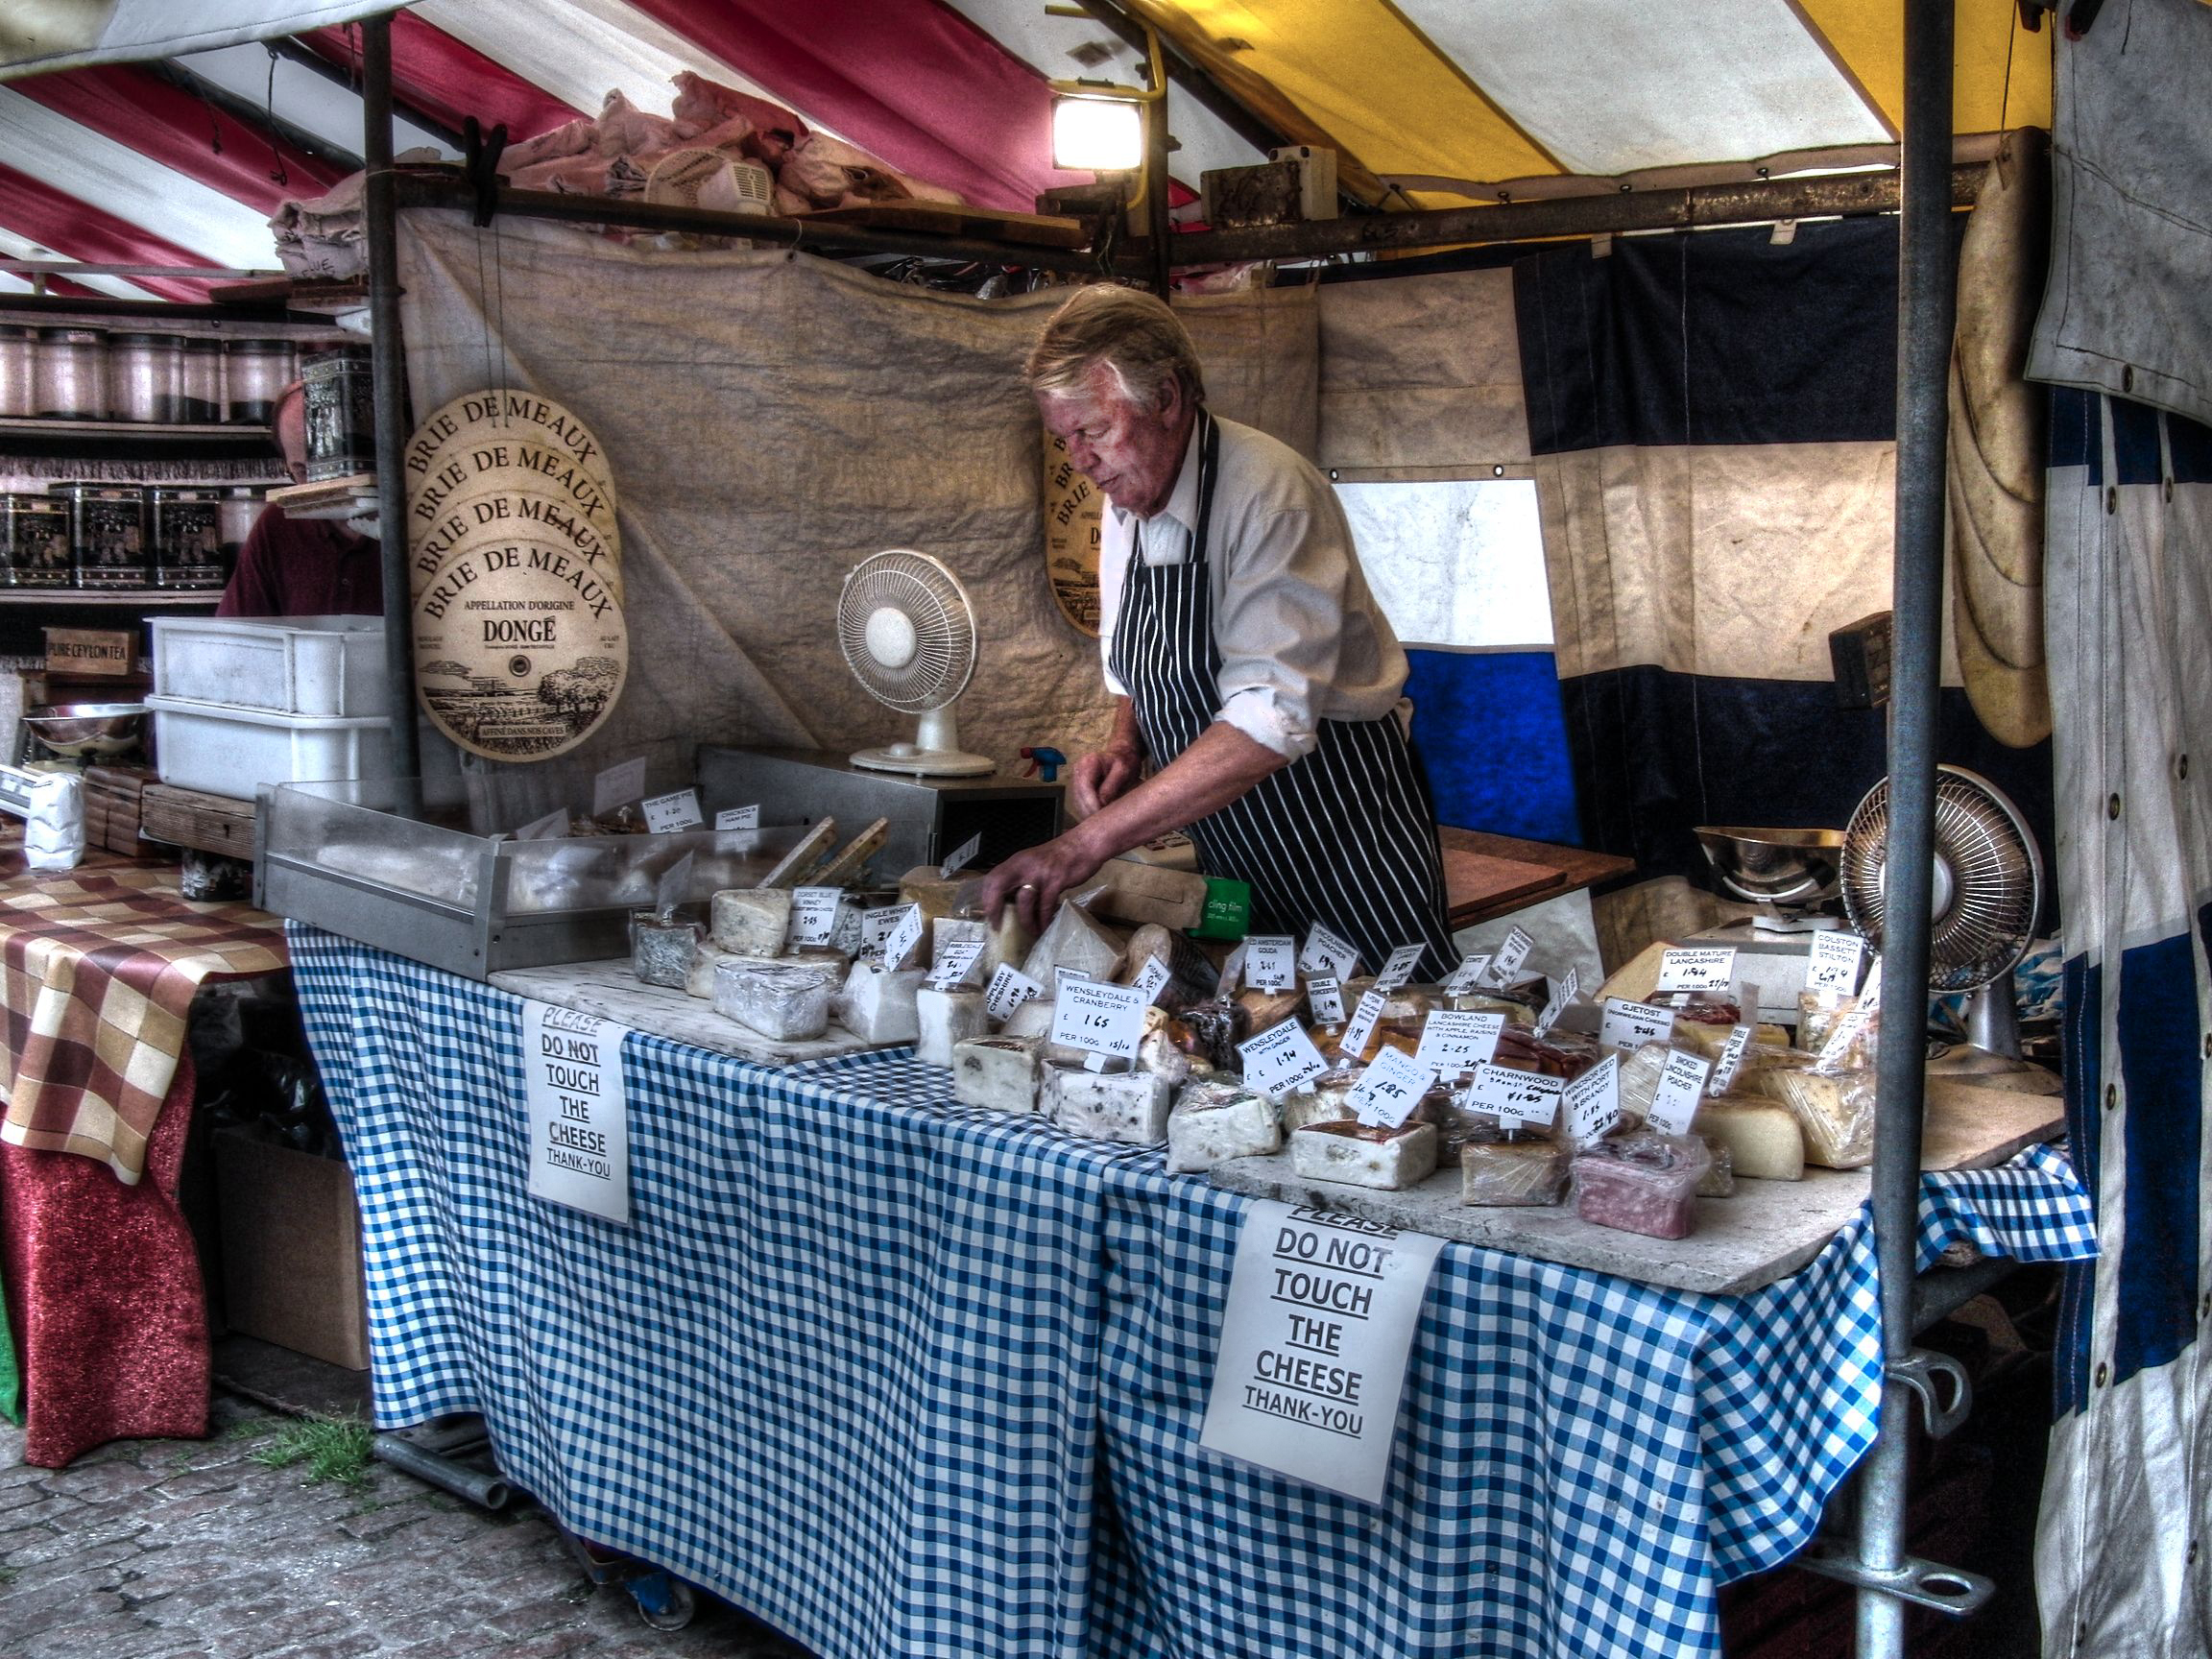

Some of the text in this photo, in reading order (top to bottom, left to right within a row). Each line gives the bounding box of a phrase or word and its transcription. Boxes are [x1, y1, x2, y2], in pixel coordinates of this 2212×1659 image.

[407, 397, 597, 474] BRIE DE MEAUX
[415, 446, 604, 521] BRIE DE MEAUX
[1057, 481, 1091, 526] BRIE
[417, 498, 607, 576] BRIE DE MEAUX
[423, 547, 613, 620] BRIE DE MEAUX
[464, 600, 575, 611] APPELLATION D'ORIGINE
[483, 615, 557, 642] DONGÉ
[73, 644, 108, 659] CEYLON
[109, 646, 126, 661] TEA
[1208, 899, 1242, 912] cling film
[878, 916, 900, 925] EWES
[1318, 937, 1346, 960] POACHER
[1818, 934, 1859, 948] COLSTON
[1818, 944, 1857, 954] BASSETT
[1818, 951, 1854, 964] STILTON
[989, 972, 1014, 1012] CHESHIRE
[1066, 984, 1131, 1004] WENSLEYDALE
[1073, 996, 1128, 1011] CRANBERRY
[542, 1006, 607, 1035] PLEASE
[1441, 1013, 1487, 1022] BOWLAND
[1623, 1003, 1661, 1017] GJETOST
[542, 1034, 599, 1063] DO NOT
[1059, 1032, 1076, 1041] PER
[1079, 1036, 1099, 1046] 100G
[1242, 1022, 1297, 1053] WENSLEYDALE
[1271, 1036, 1290, 1048] GINGER
[1619, 1040, 1633, 1048] PER
[1380, 1062, 1416, 1086] GINGER
[1384, 1052, 1419, 1076] MANGO
[1665, 1063, 1703, 1084] LINCOLNSHIRE
[1675, 1055, 1697, 1070] SMOKED
[545, 1064, 600, 1093] TOUCH
[1269, 1073, 1304, 1094] PER 100G
[1482, 1068, 1558, 1087] CHARNWOOD
[1565, 1058, 1615, 1096] WINDSOR RED
[1572, 1070, 1611, 1101] WITH PORT
[1667, 1074, 1693, 1091] POACHER
[1579, 1080, 1610, 1106] BRANDY
[559, 1095, 589, 1119] THE
[1353, 1094, 1395, 1123] PER 100G
[1472, 1101, 1494, 1111] PER
[1499, 1106, 1524, 1116] 100G
[1647, 1114, 1660, 1123] PER
[549, 1121, 606, 1153] CHEESE
[546, 1147, 611, 1177] THANK-YOU
[1275, 1227, 1393, 1274] DO NOT
[1274, 1267, 1374, 1314] TOUCH
[1288, 1313, 1343, 1352] THE
[1256, 1350, 1362, 1401] CHEESE
[1244, 1384, 1363, 1435] THANK-YOU
